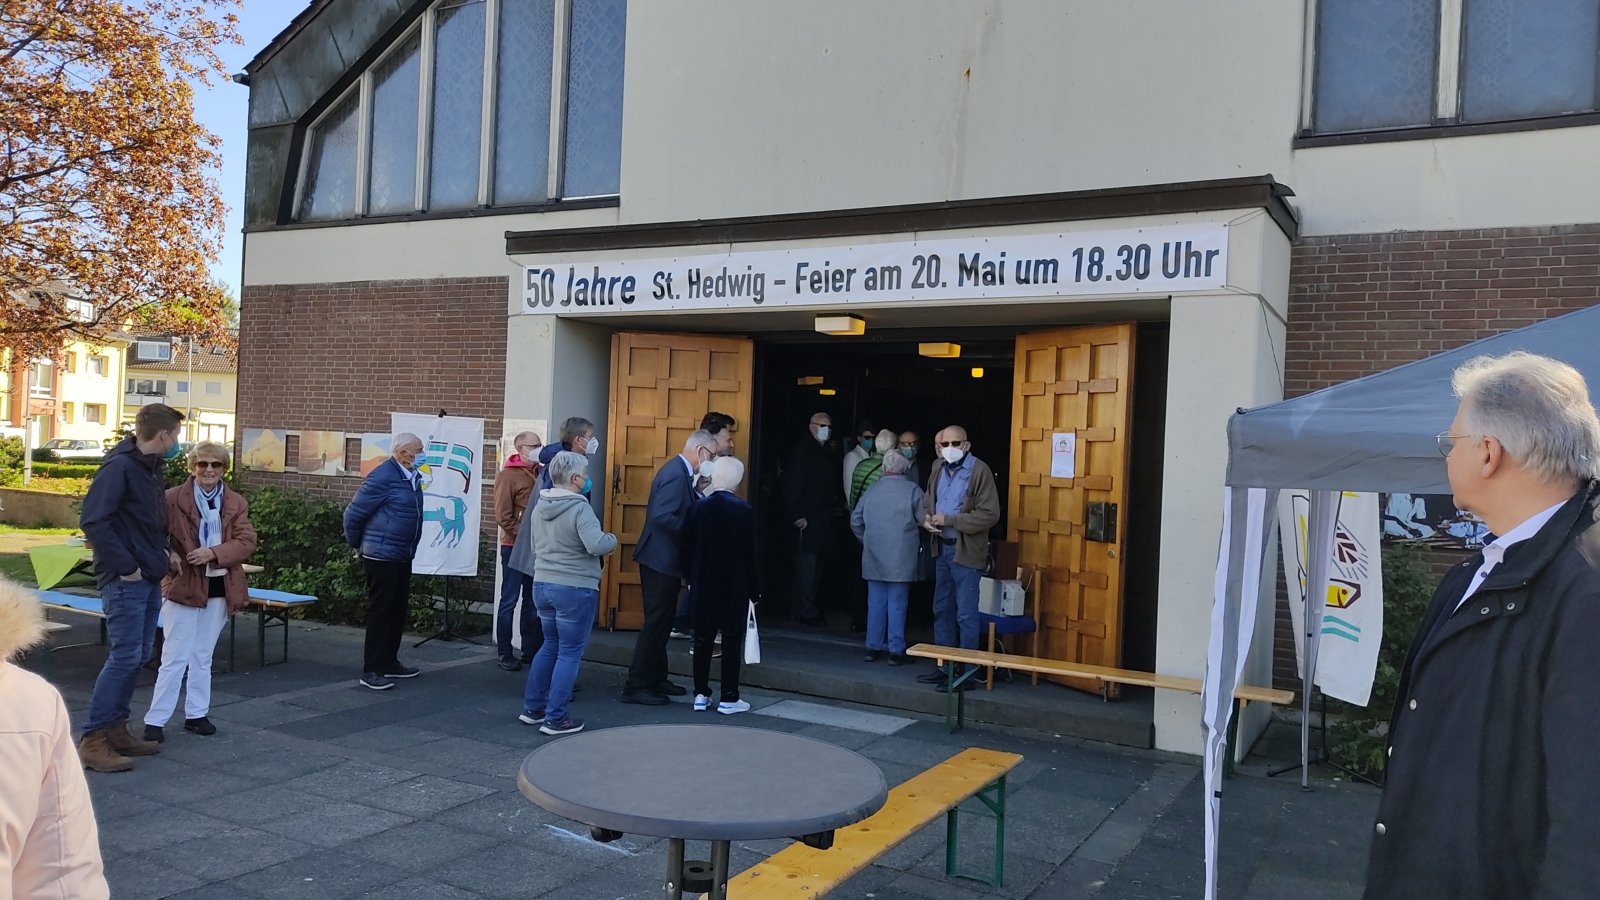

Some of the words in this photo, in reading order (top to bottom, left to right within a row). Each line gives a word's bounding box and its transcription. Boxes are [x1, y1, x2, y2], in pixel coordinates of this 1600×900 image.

[526, 268, 556, 308] 50
[560, 265, 636, 307] Jahre
[652, 270, 681, 301] St.
[687, 264, 766, 305] Hedwig
[795, 260, 857, 295] Feier
[864, 265, 902, 292] am
[911, 253, 948, 289] 20.
[957, 251, 1007, 288] Mai
[1015, 258, 1060, 286] um
[1072, 243, 1152, 283] 18.30
[1161, 240, 1220, 280] Uhr
